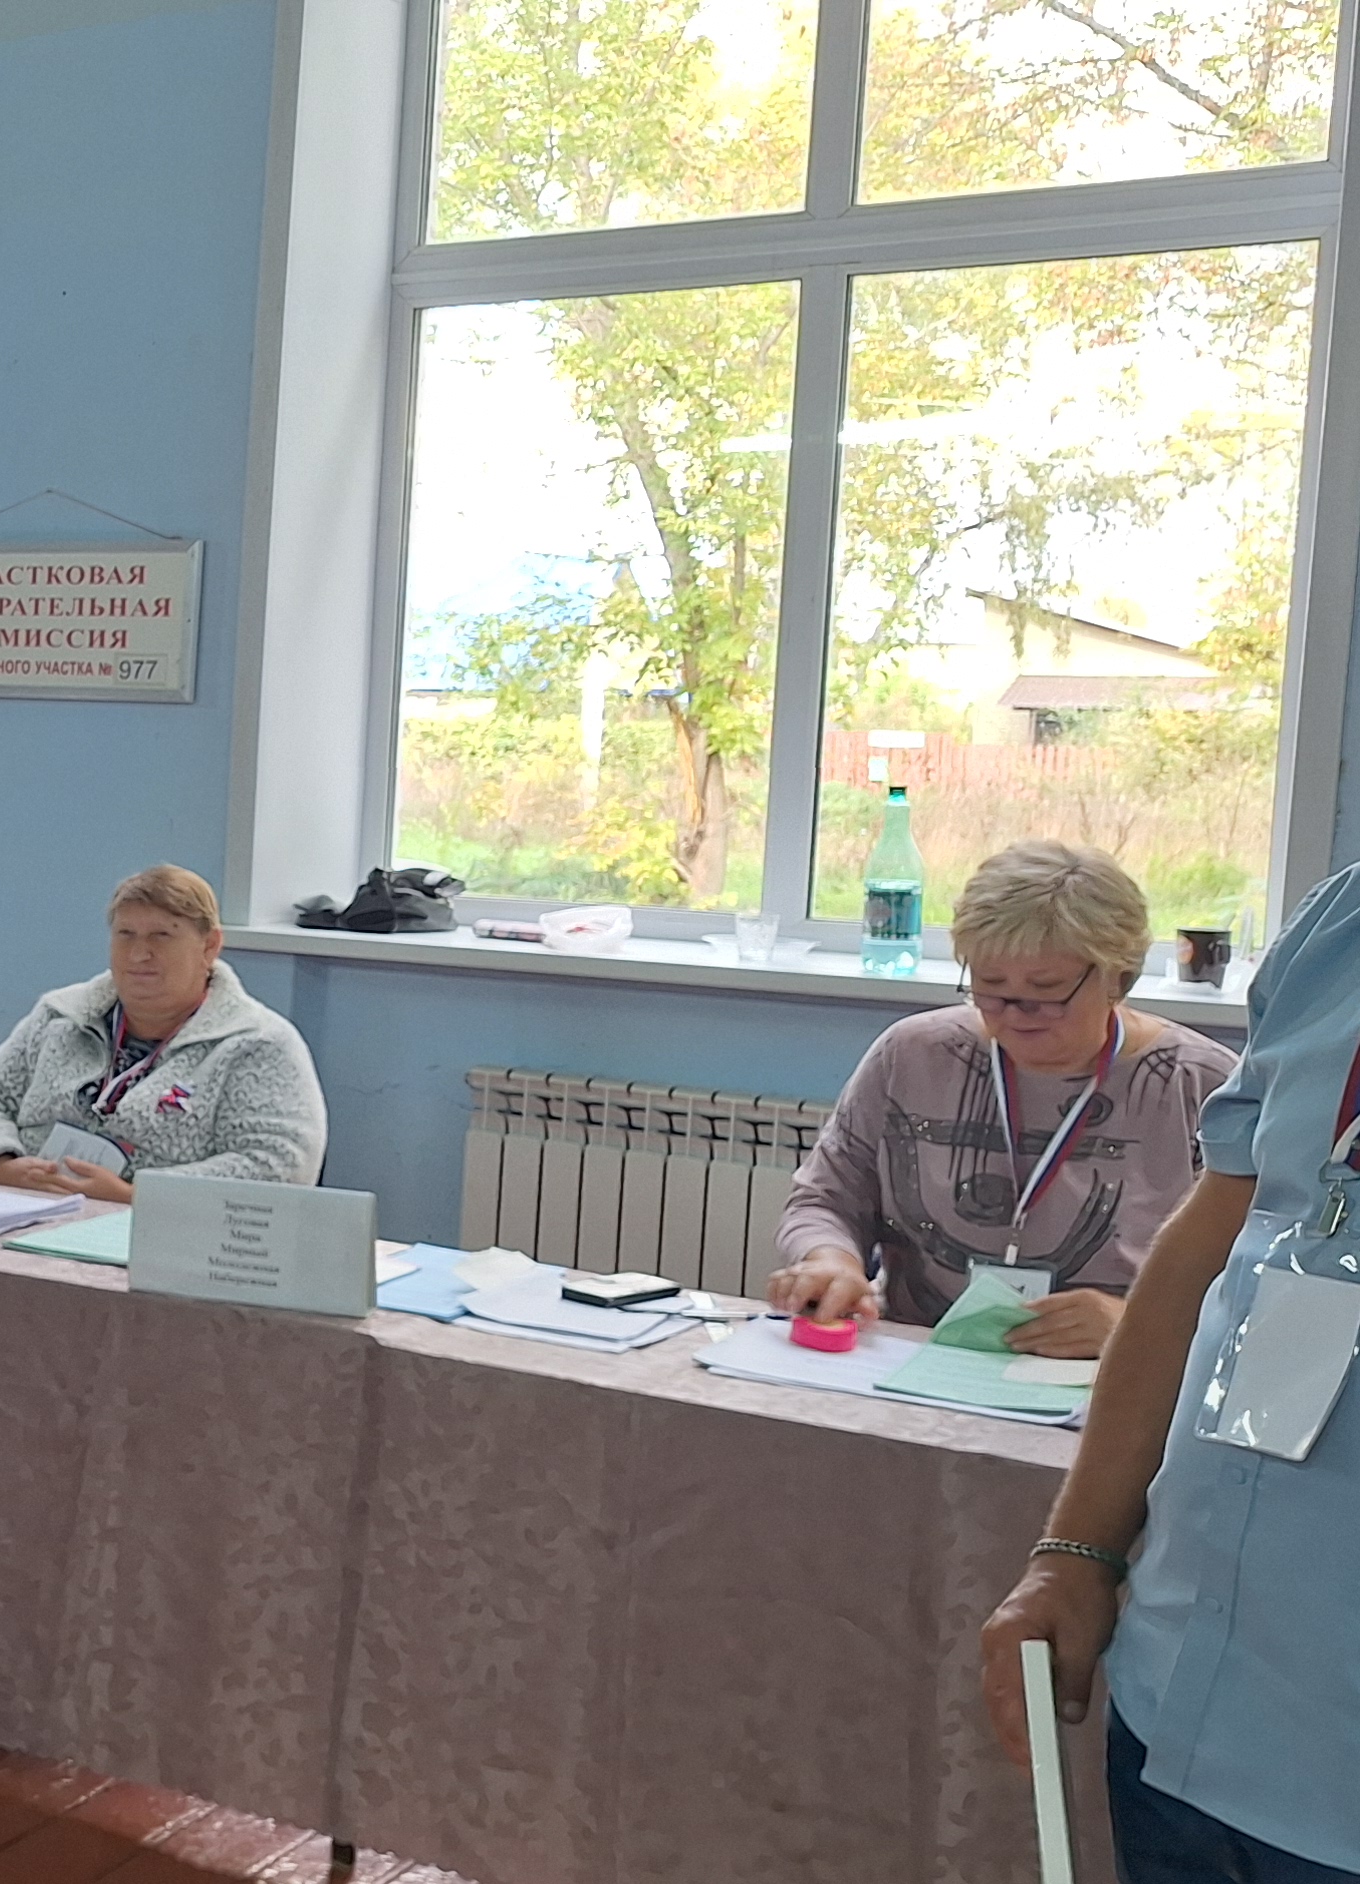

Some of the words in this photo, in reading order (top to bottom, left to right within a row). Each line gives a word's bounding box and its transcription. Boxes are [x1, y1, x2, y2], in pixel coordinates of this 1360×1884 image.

[35, 661, 94, 676] УЧАСТКА
[98, 662, 113, 676] №
[118, 659, 159, 681] 977
